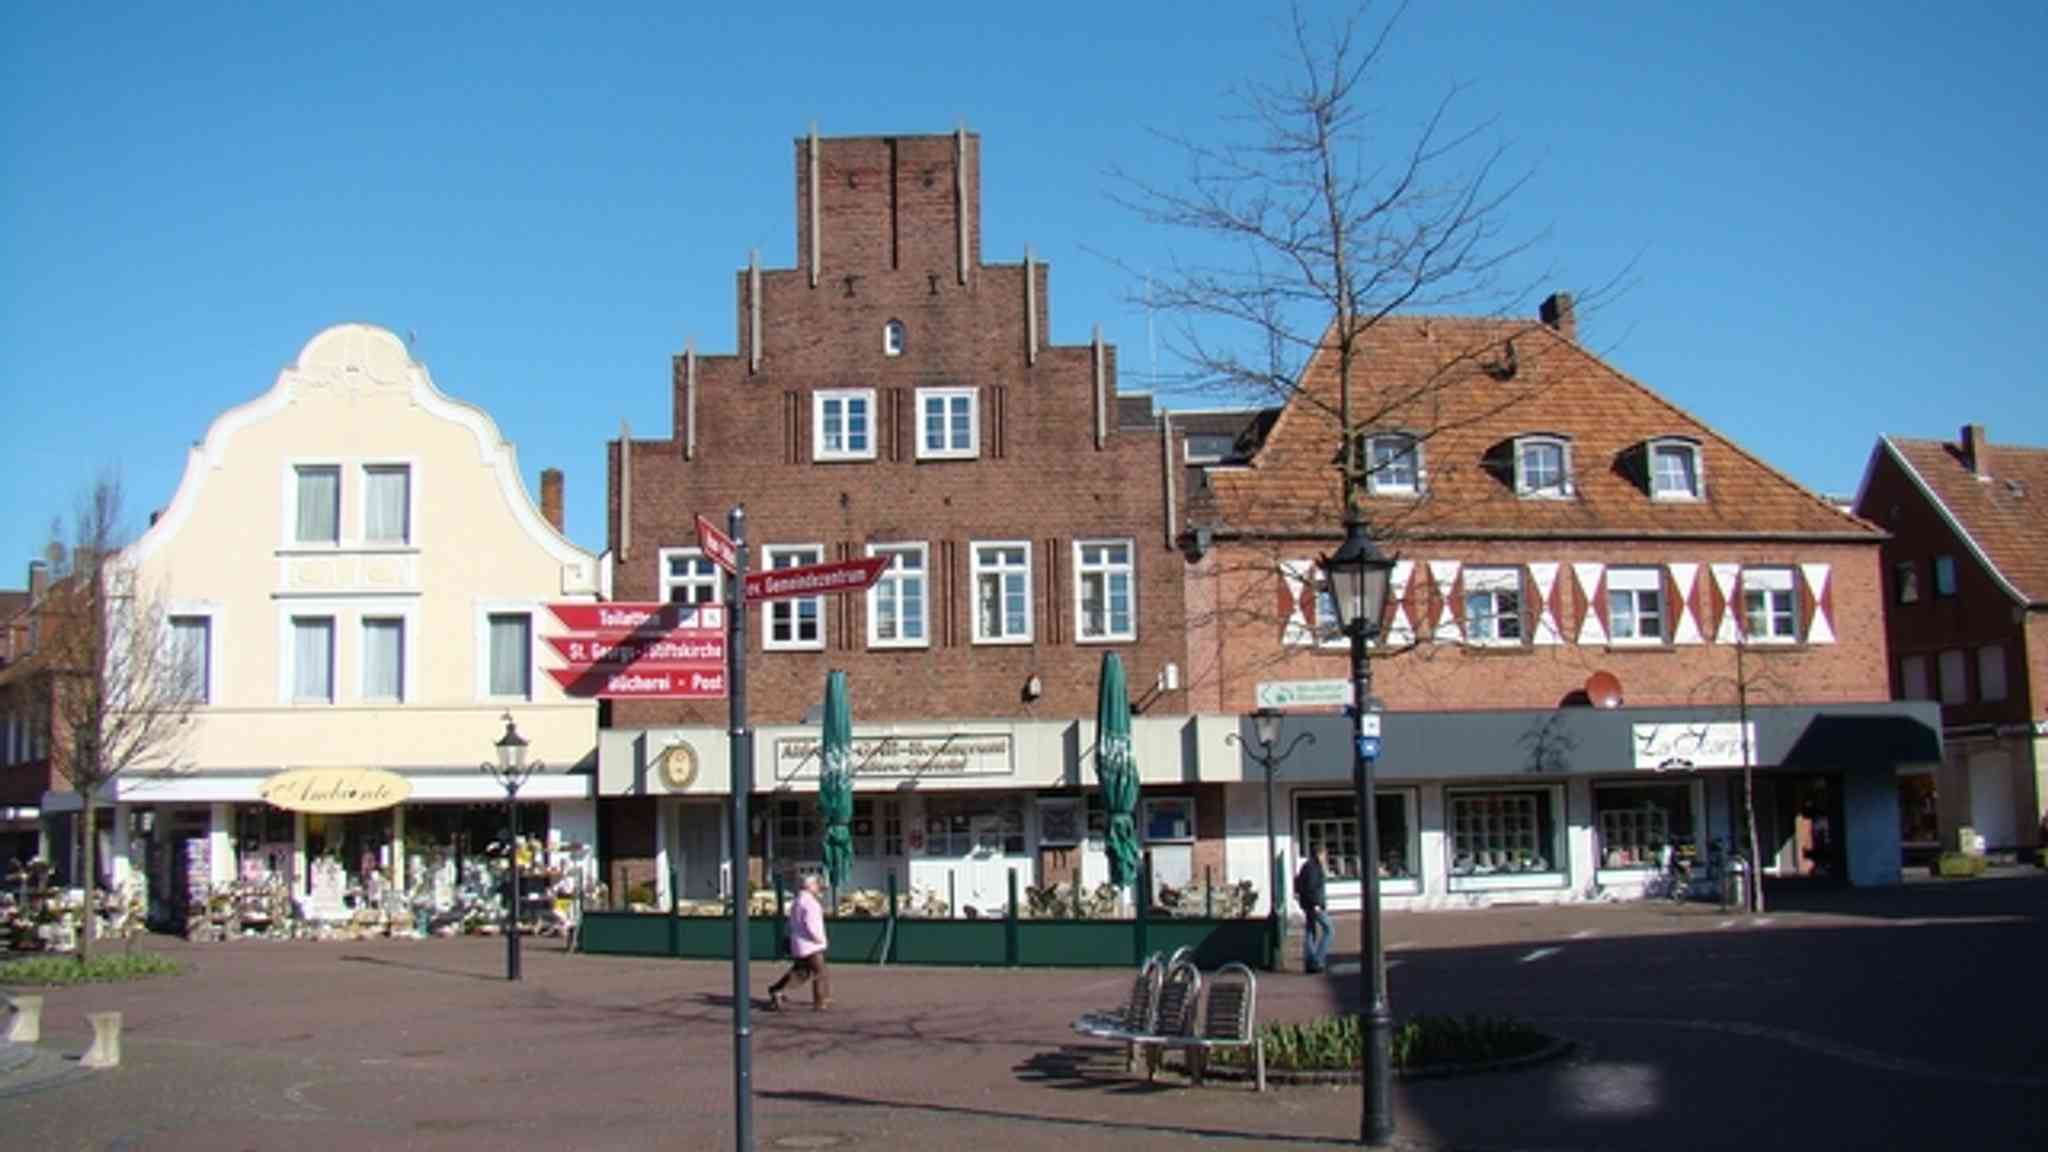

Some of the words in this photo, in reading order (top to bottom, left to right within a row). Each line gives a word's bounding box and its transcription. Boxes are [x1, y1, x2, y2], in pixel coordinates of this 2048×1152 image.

[765, 568, 867, 594] Gemeindezentrum
[600, 607, 662, 627] Toiletten
[569, 642, 588, 661] St.
[607, 672, 672, 692] Bücherei
[691, 672, 722, 692] Post
